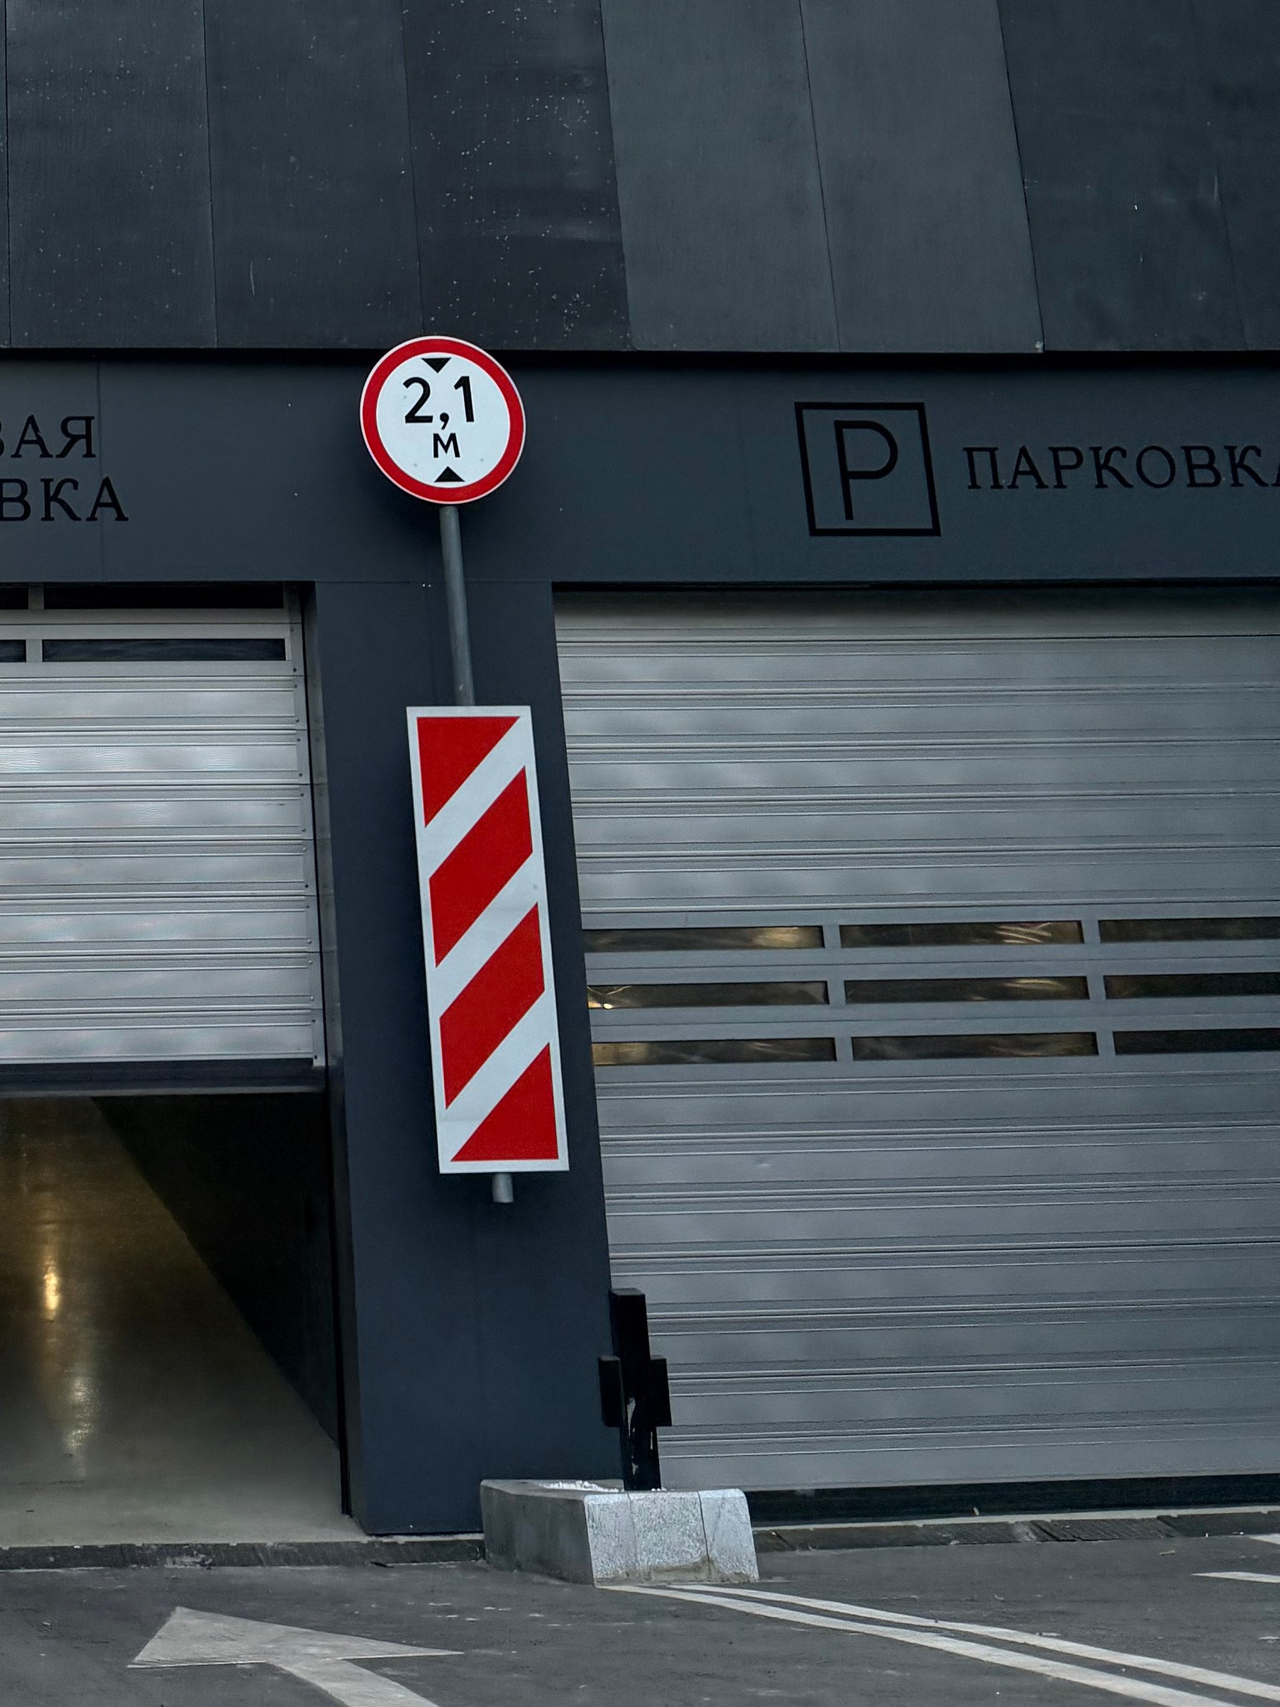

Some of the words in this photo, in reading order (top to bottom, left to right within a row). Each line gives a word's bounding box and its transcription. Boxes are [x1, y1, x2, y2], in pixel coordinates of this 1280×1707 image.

[403, 376, 475, 430] 2,1
[834, 420, 898, 521] P
[963, 445, 1280, 489] ПАРКОВК
